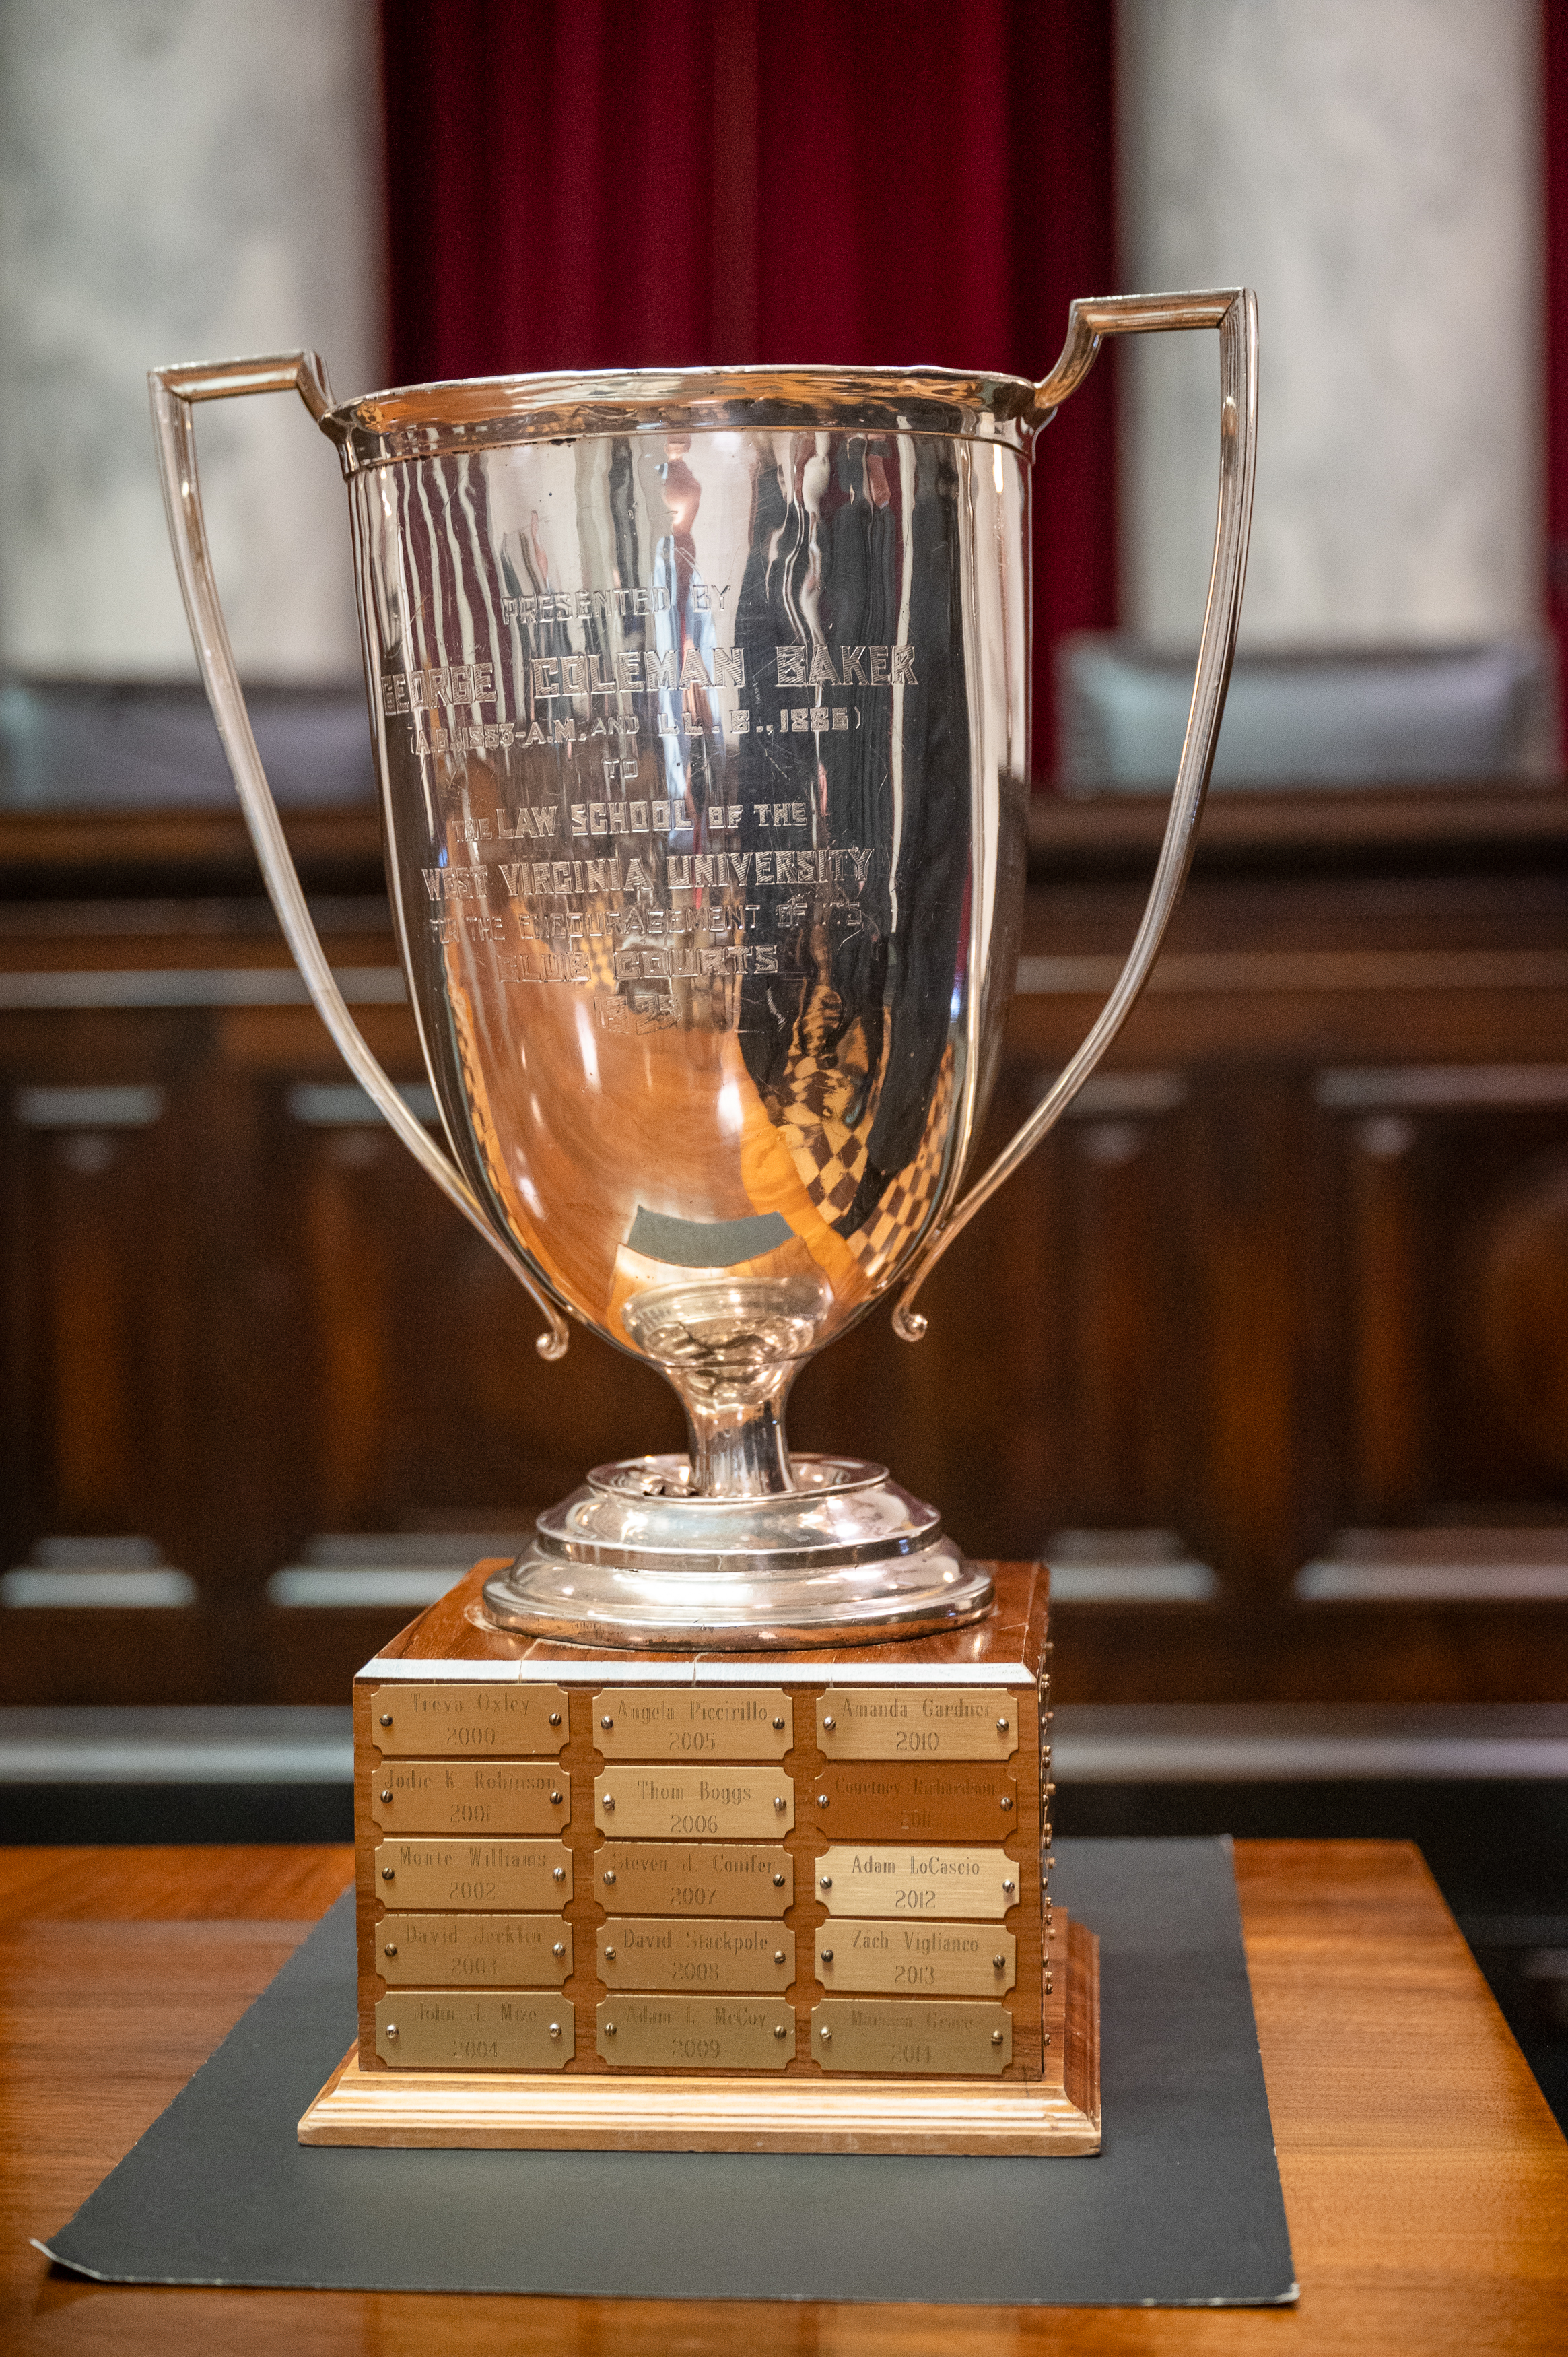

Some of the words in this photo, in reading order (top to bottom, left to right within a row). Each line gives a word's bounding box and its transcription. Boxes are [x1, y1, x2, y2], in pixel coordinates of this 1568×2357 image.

[502, 585, 671, 625] PRESENTED
[692, 584, 731, 613] BY
[531, 646, 746, 698] COLEMAN
[775, 645, 918, 688] BAKER
[601, 758, 638, 778] TO
[452, 818, 493, 842] THE
[496, 805, 558, 840] LAW
[570, 799, 694, 836] SCHOOL
[708, 805, 743, 829] OF
[754, 802, 808, 826] THE
[421, 865, 487, 901] WEST
[498, 858, 654, 897] VIRGINIA
[666, 848, 874, 890] UNIVERSITY
[613, 945, 778, 979] COURTS
[410, 1692, 463, 1713] Treva
[477, 1692, 530, 1715] Oxley
[617, 1700, 675, 1725] Angela
[690, 1700, 768, 1721] Piccirillo
[842, 1698, 908, 1718] Amanda
[922, 1698, 993, 1718] Gardner
[446, 1727, 496, 1746] 2000
[669, 1731, 716, 1751] 2005
[896, 1731, 939, 1751] 2010
[384, 1769, 432, 1790] Jodie
[474, 1770, 557, 1791] Robinson
[835, 1777, 901, 1799] Courtney
[913, 1777, 996, 1796] Richardson
[638, 1780, 684, 1800] Thom
[700, 1780, 751, 1805] Boggs
[450, 1803, 491, 1823] 2001
[671, 1814, 718, 1834] 2006
[399, 1846, 453, 1867] Monte
[469, 1847, 546, 1867] Williams
[613, 1852, 668, 1872] Steven
[852, 1855, 896, 1874] Adam
[910, 1855, 980, 1875] LoCascio
[450, 1882, 496, 1901] 2002
[671, 1887, 718, 1906] 2007
[895, 1890, 936, 1909] 2012
[406, 1924, 458, 1944] David
[623, 1929, 672, 1948] David
[687, 1930, 769, 1954] Stackpole
[852, 1930, 889, 1950] Zach
[904, 1931, 979, 1955] Viglianco
[451, 1957, 498, 1976] 2003
[673, 1962, 720, 1981] 2008
[895, 1965, 936, 1985] 2013
[413, 2002, 456, 2022] John
[626, 2005, 671, 2024] Adam
[715, 2007, 766, 2028] McCoy
[453, 2040, 499, 2059] 2004
[673, 2039, 721, 2059] 2009
